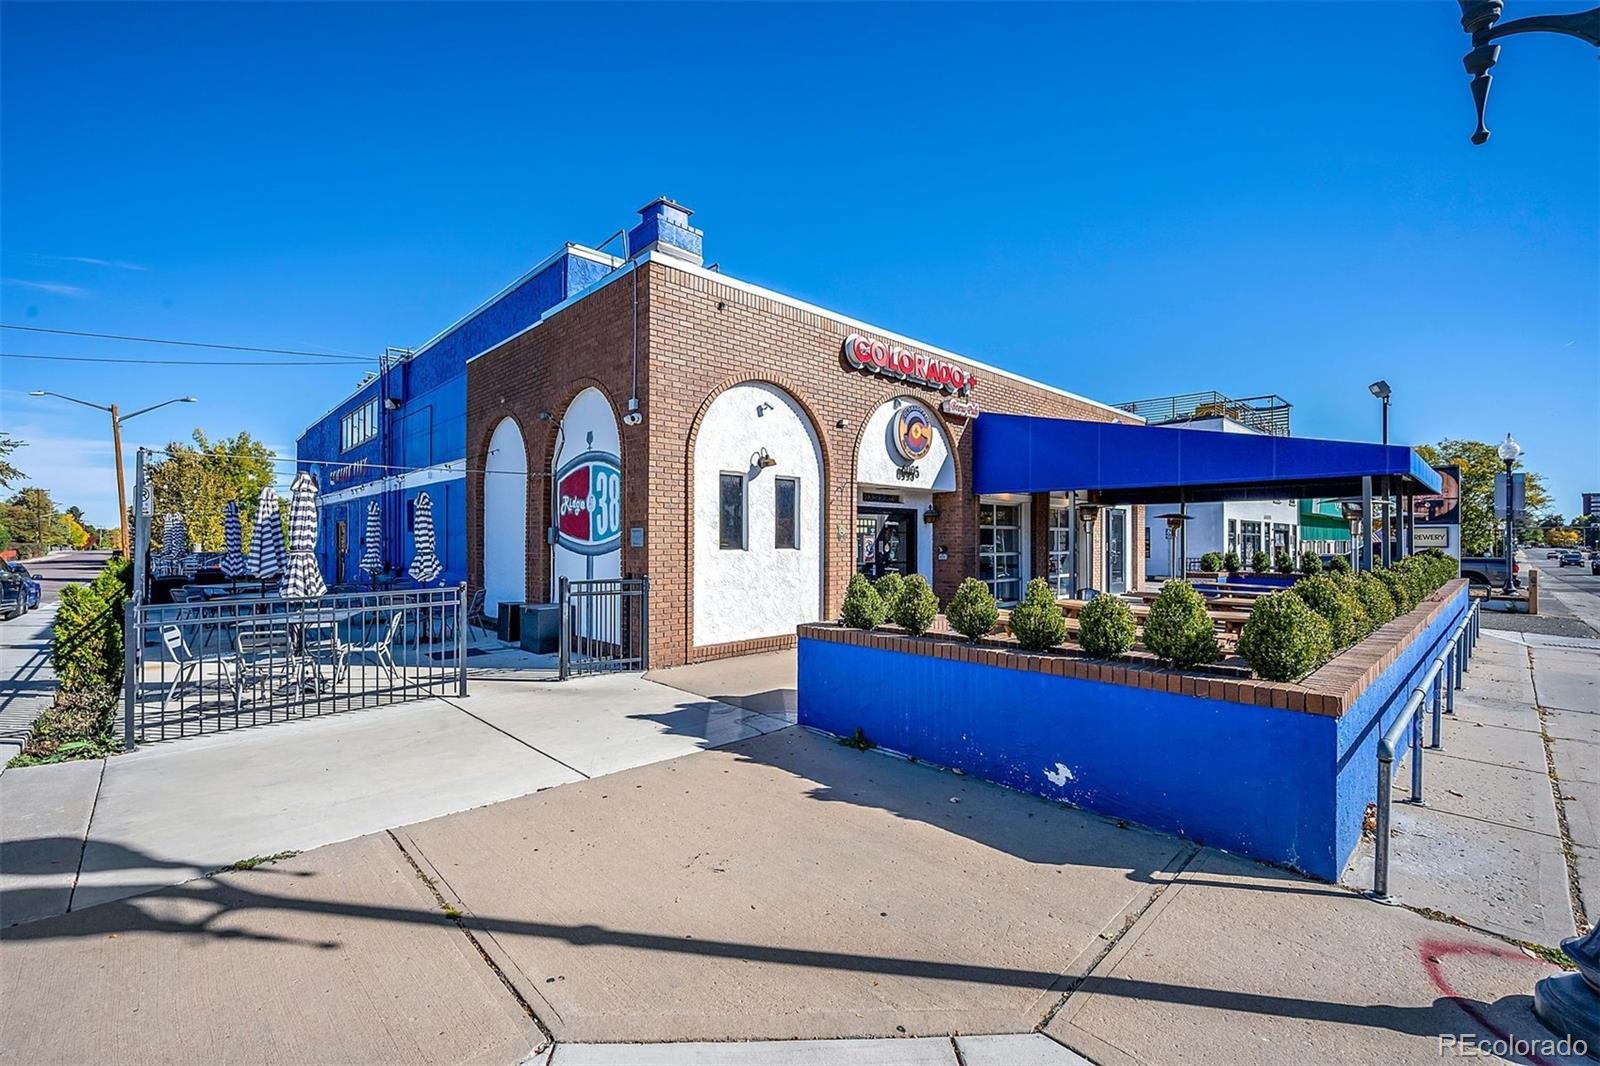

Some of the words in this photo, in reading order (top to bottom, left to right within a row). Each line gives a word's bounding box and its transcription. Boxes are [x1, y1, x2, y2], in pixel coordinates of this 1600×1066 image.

[854, 335, 965, 389] COLORADO
[561, 495, 586, 516] Ridge
[597, 471, 620, 535] 38
